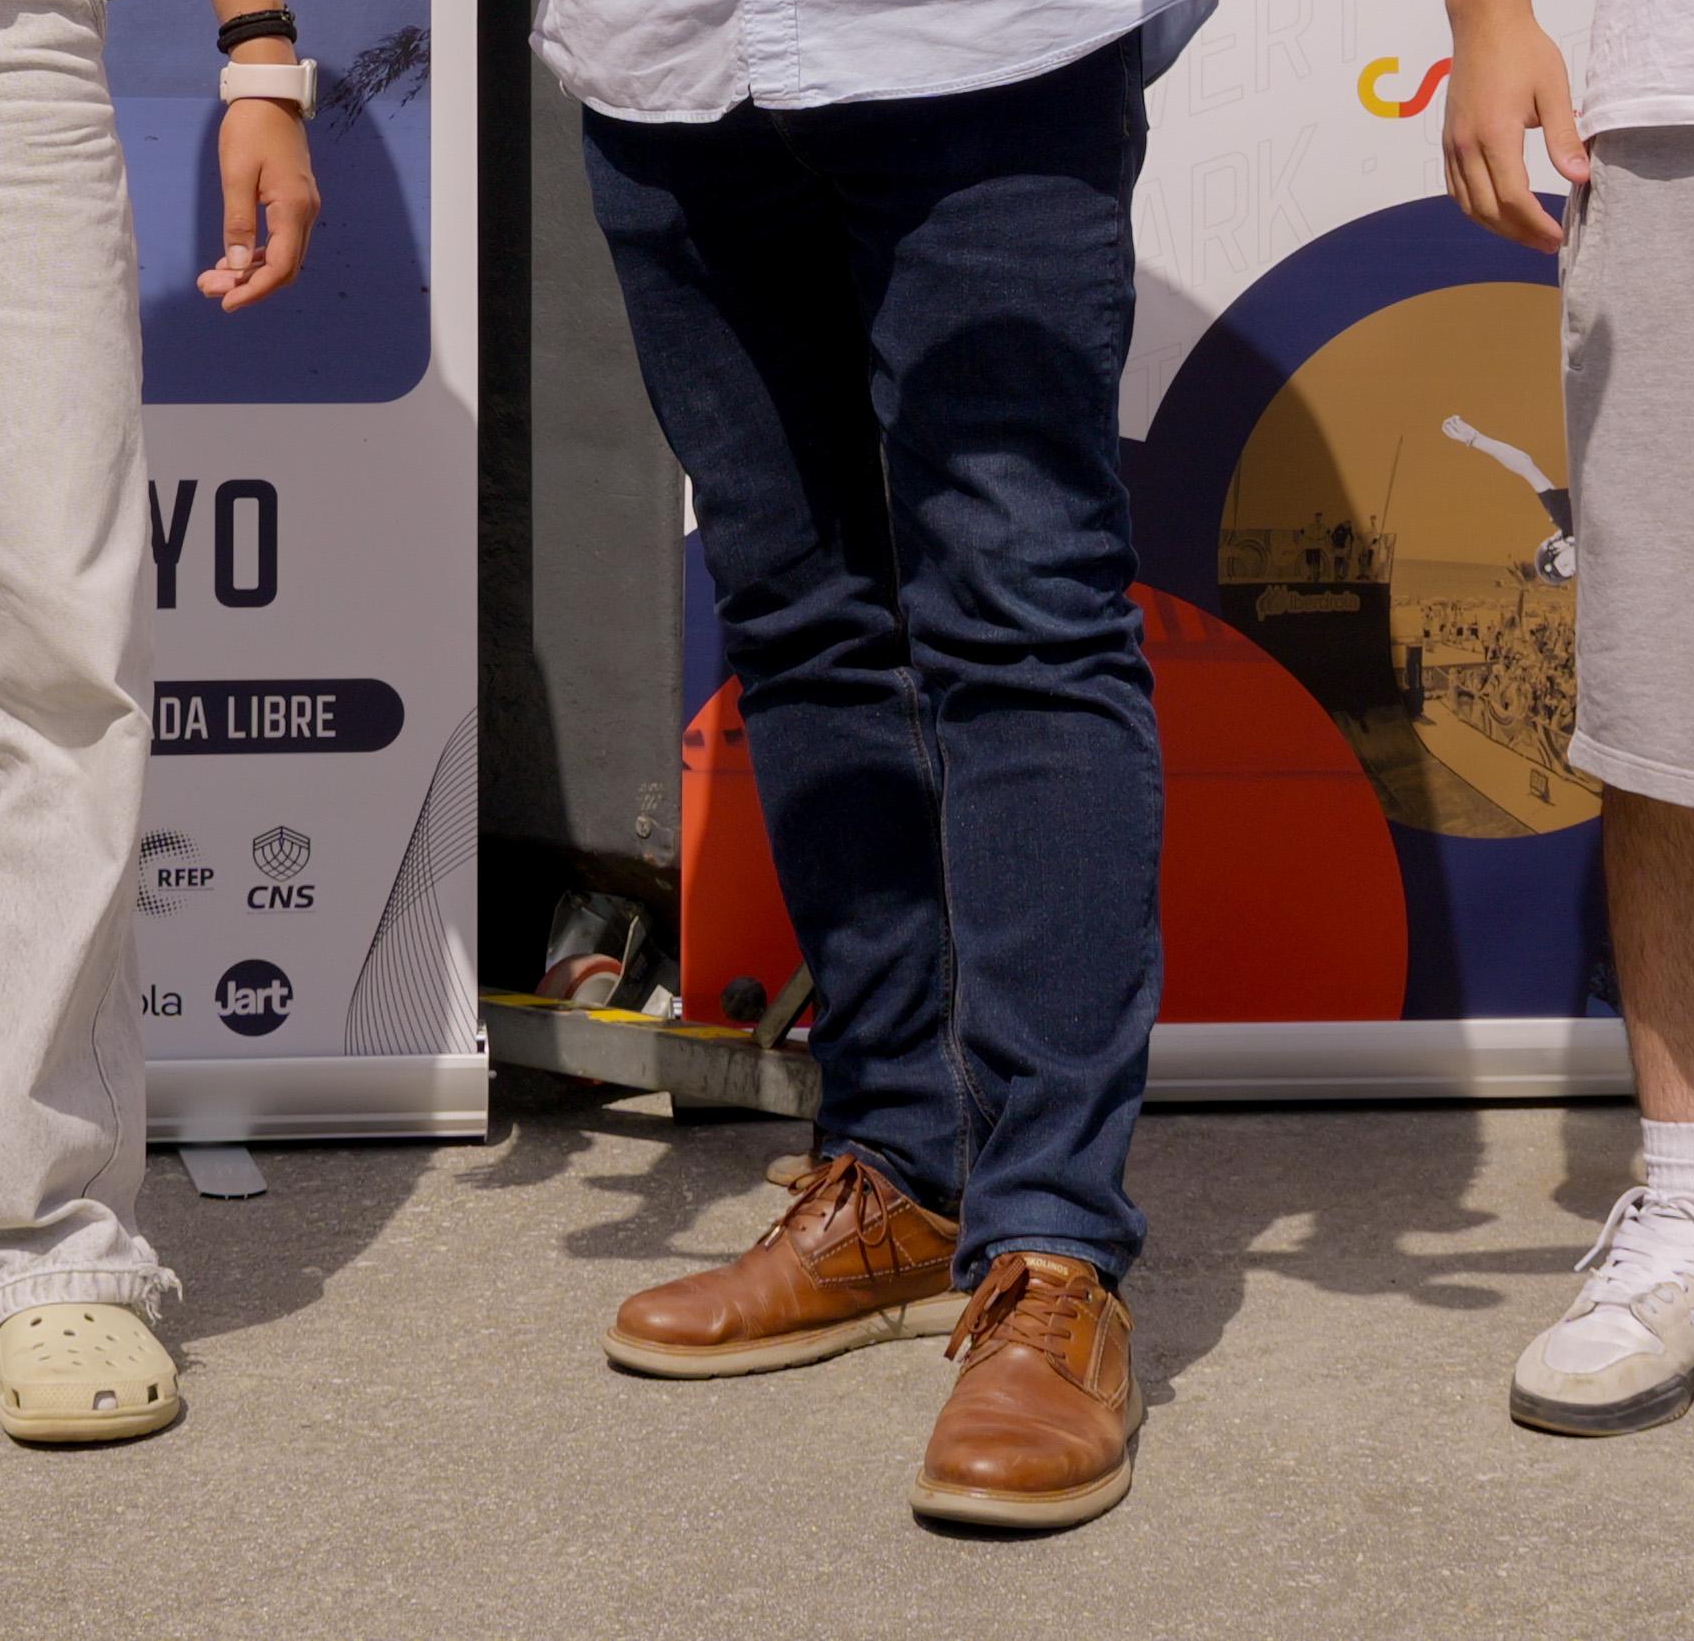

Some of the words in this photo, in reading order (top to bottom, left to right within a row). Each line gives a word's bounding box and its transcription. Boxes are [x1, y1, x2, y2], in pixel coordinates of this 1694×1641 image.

[227, 694, 337, 739] LIBRE
[158, 868, 214, 887] RFEP
[247, 885, 315, 910] CNS
[215, 978, 293, 1016] Jart
